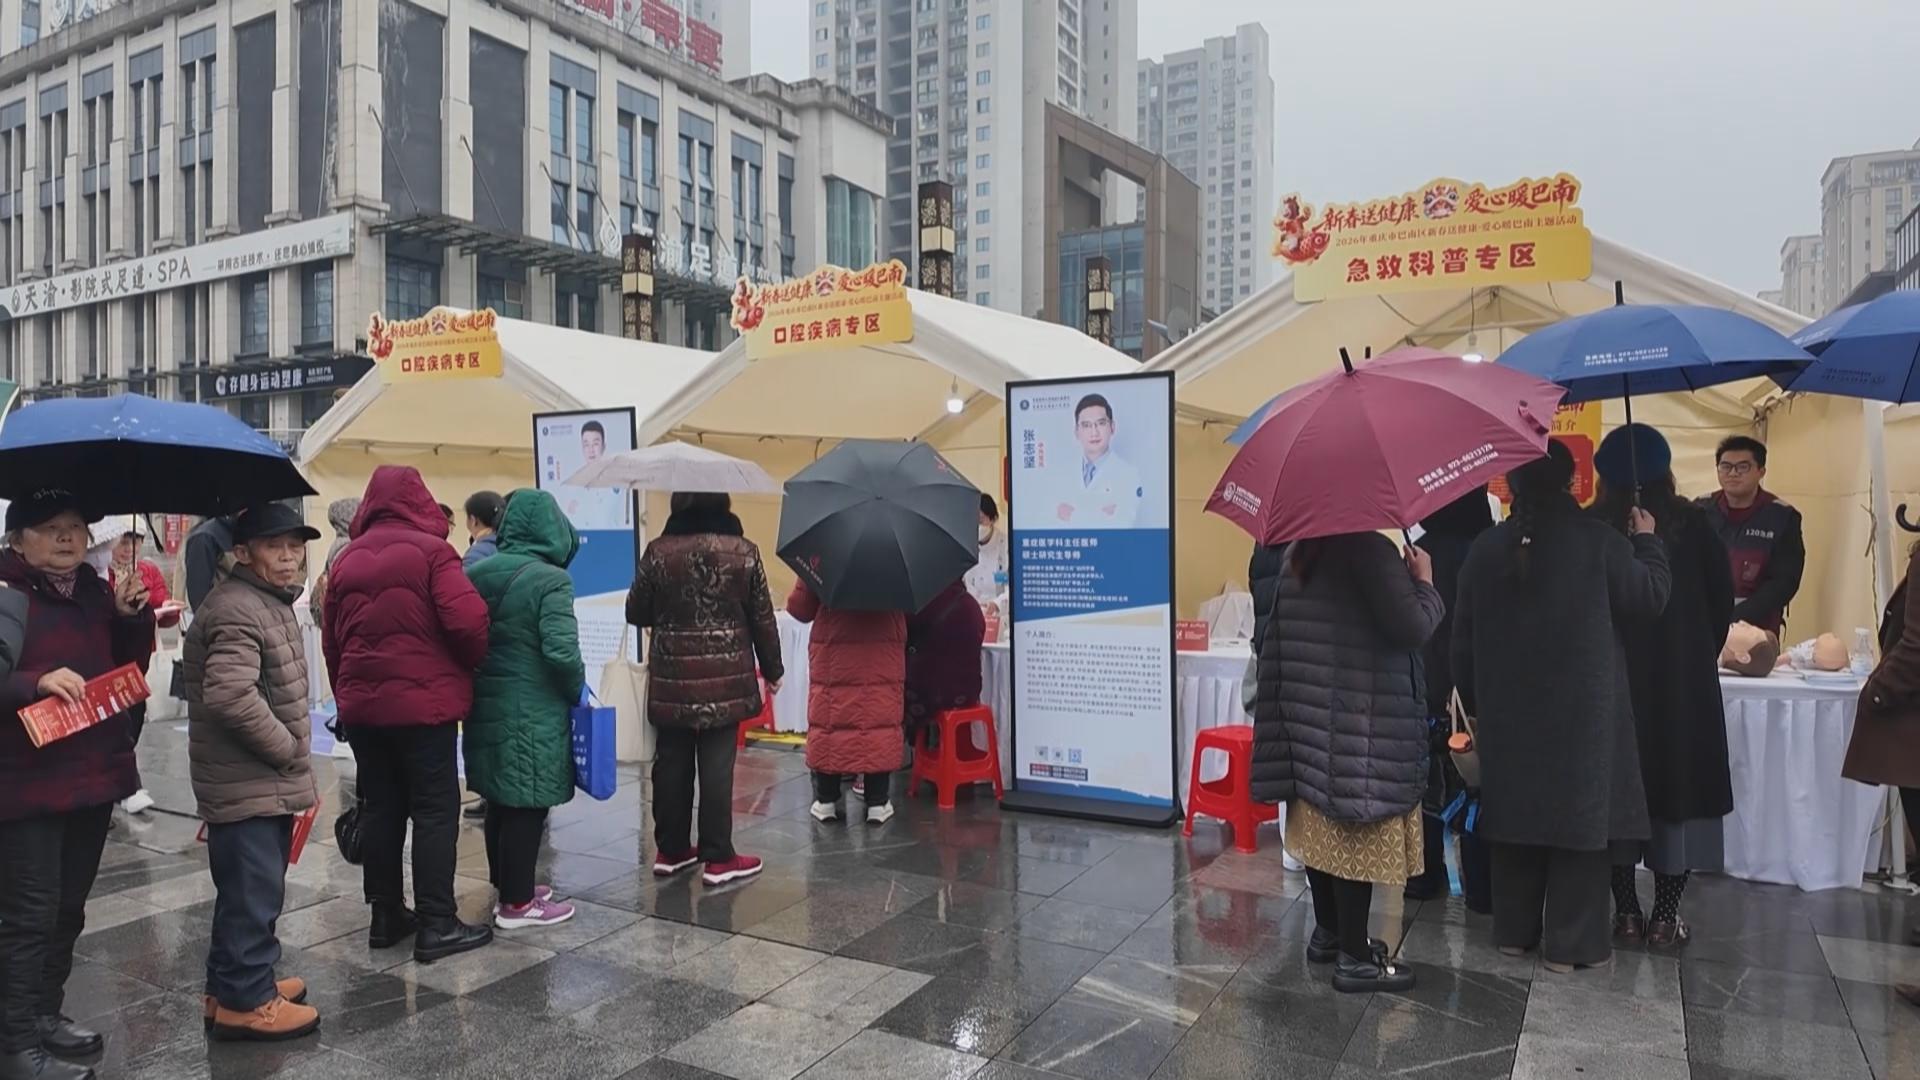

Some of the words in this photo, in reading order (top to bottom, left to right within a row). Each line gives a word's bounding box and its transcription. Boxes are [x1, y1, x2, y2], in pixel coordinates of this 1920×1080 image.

[1313, 196, 1420, 233] 新春送健康
[1464, 178, 1577, 215] 爱心暖巴南
[1346, 242, 1536, 283] 急救科普专区
[774, 312, 881, 344] 口腔疾病专区
[401, 351, 480, 372] 口腔疾病专区
